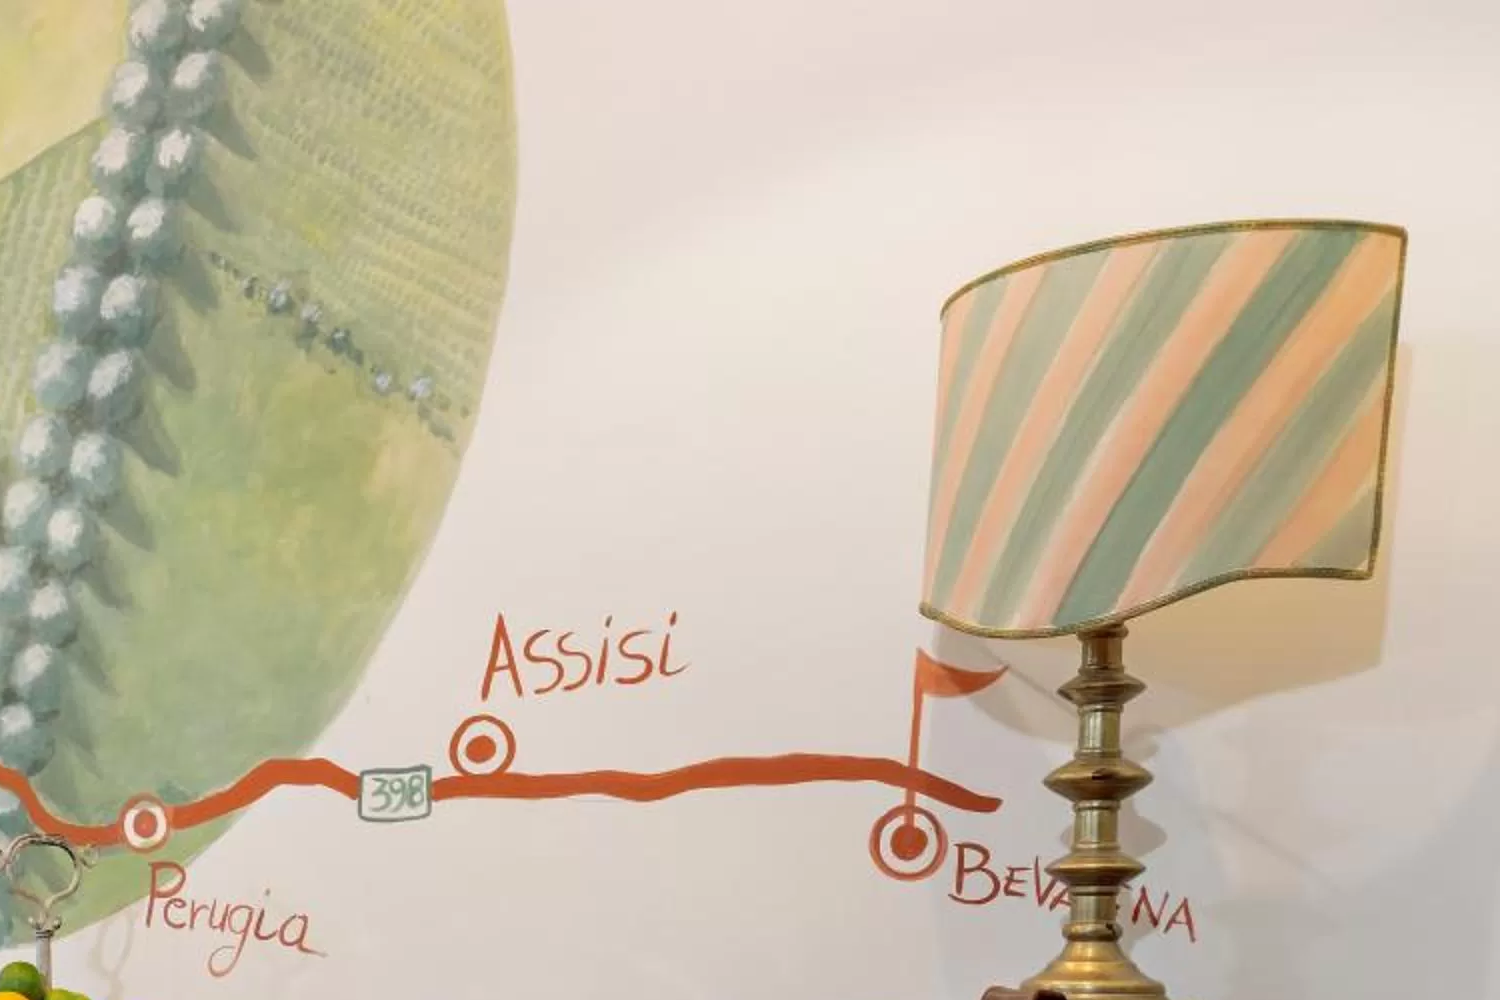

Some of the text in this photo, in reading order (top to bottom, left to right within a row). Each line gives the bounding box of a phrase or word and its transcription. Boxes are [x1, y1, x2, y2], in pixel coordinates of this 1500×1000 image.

[368, 774, 426, 812] 398
[146, 861, 328, 977] Perugia
[948, 842, 1196, 943] BEVNA
